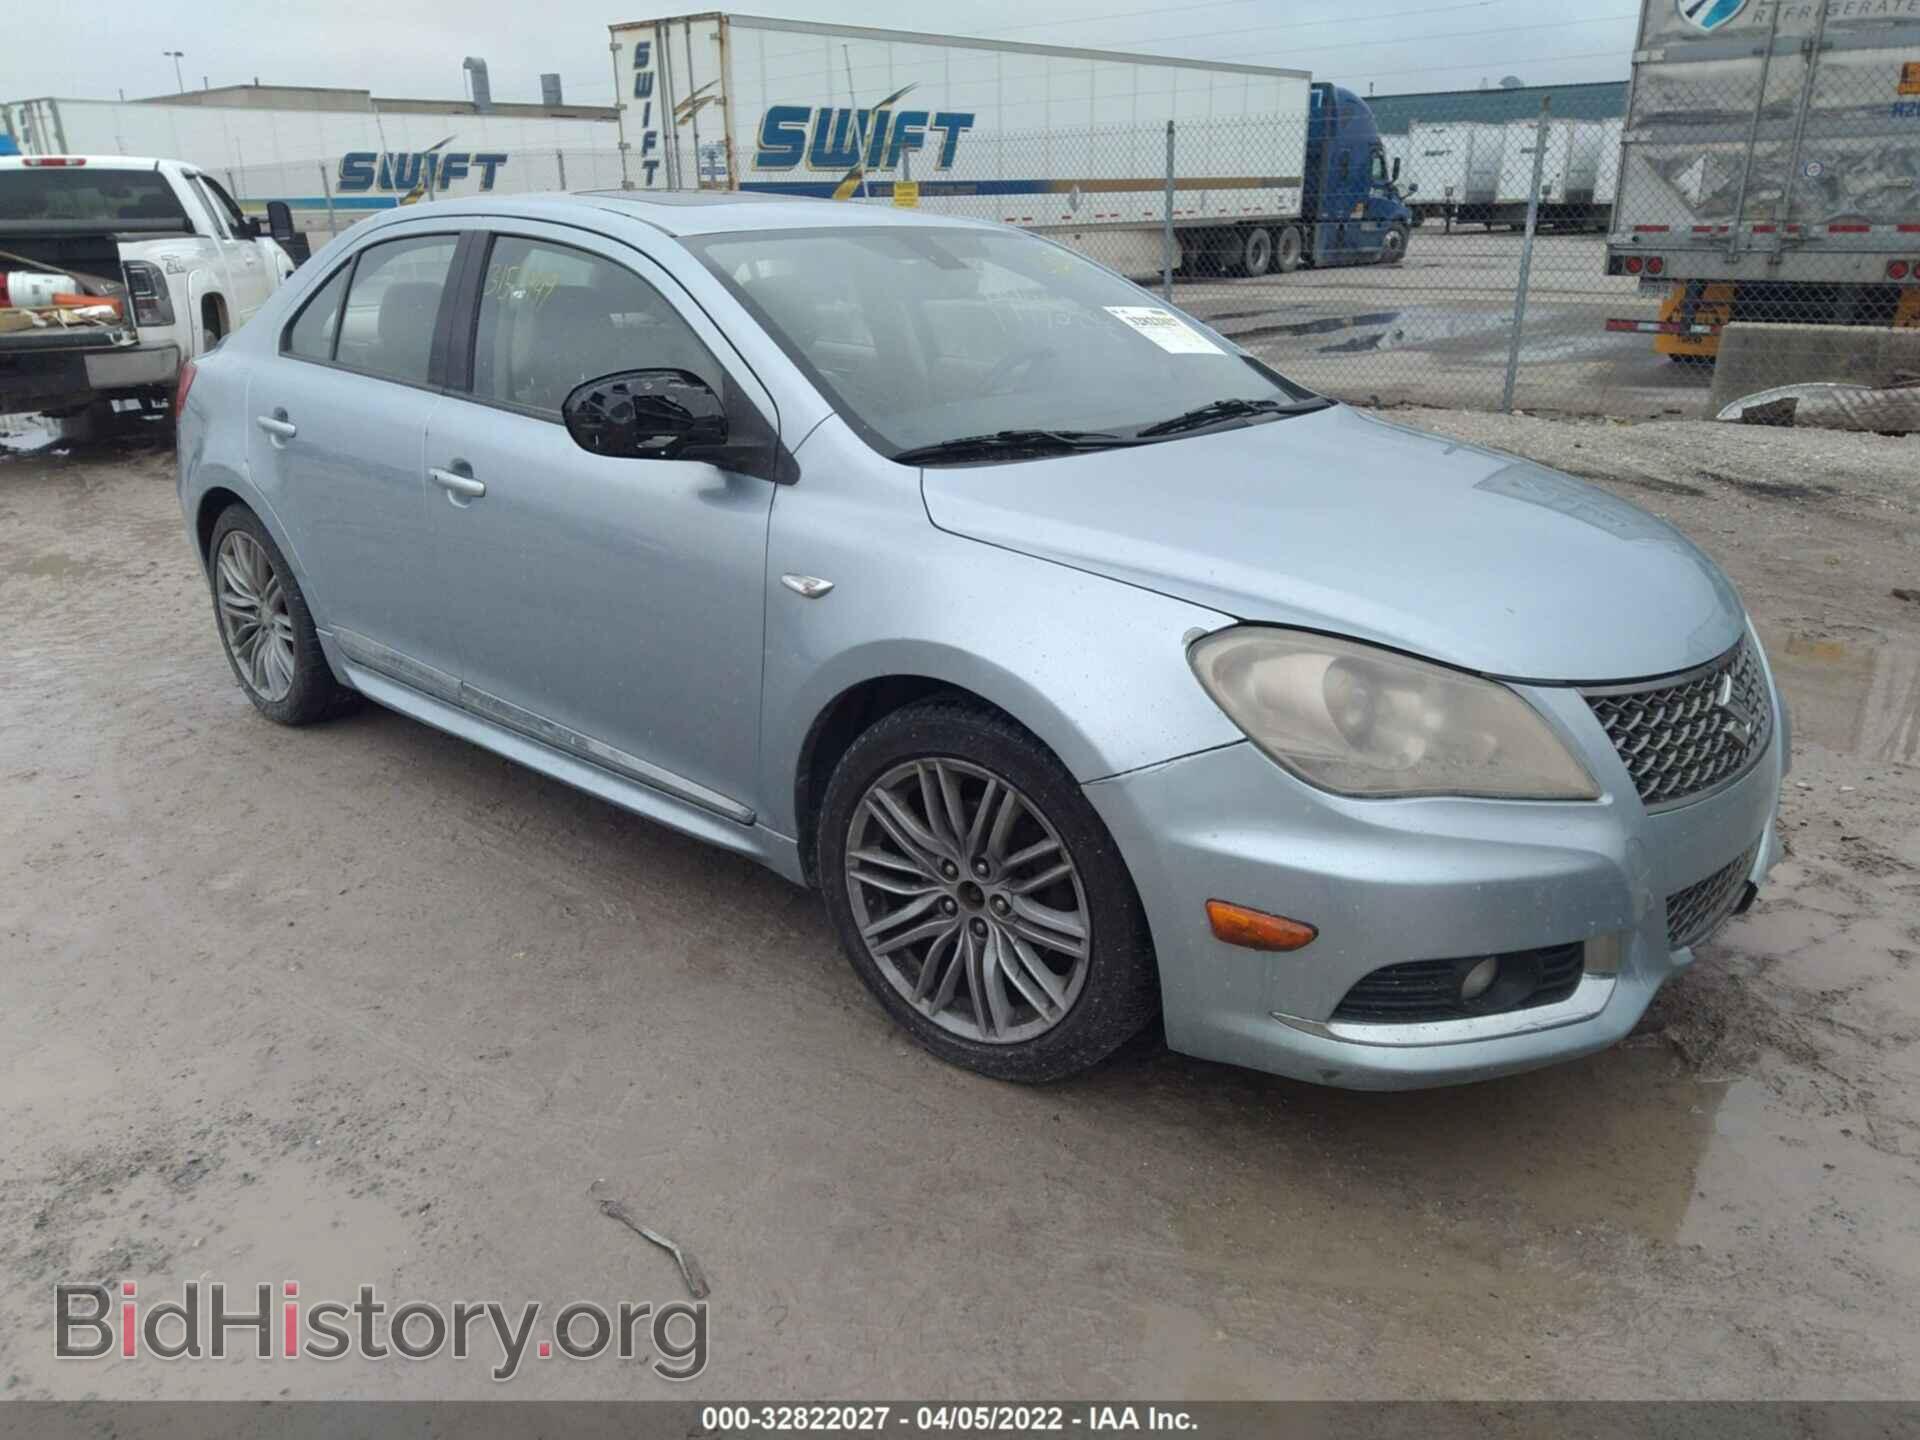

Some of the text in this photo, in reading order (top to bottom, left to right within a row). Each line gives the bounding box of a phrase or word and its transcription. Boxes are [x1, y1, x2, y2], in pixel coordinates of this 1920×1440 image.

[633, 41, 660, 186] SWIFT
[752, 105, 976, 172] SWIFT
[336, 152, 509, 192] SWIFT
